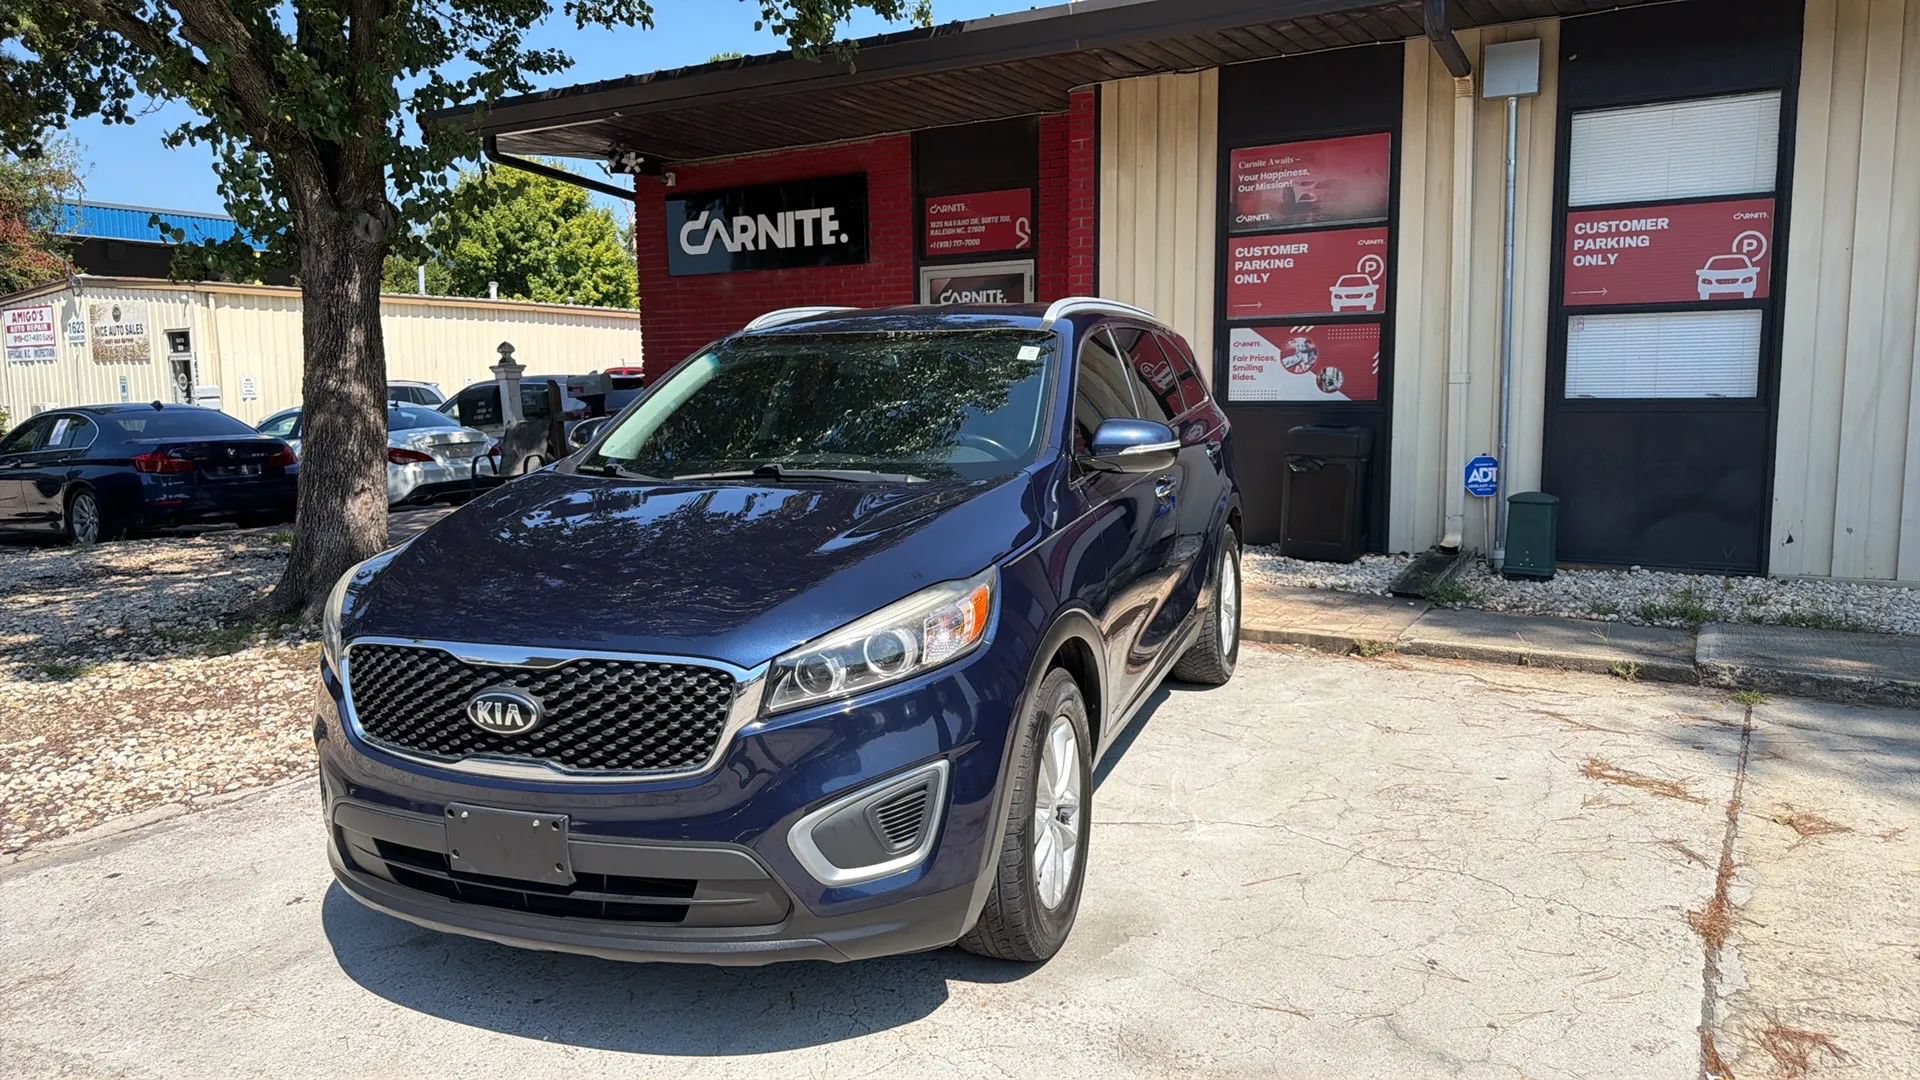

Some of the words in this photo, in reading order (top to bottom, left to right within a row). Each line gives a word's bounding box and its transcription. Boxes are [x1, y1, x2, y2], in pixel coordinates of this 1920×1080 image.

[1238, 160, 1266, 169] Carnite
[1268, 157, 1294, 166] Awaits
[1238, 174, 1258, 182] Your
[1238, 184, 1256, 193] Our
[1256, 180, 1293, 191] Mission!
[930, 227, 955, 236] RALEIGH
[1574, 217, 1669, 235] CUSTOMER
[1573, 235, 1650, 251] PARKING
[1235, 243, 1308, 258] CUSTOMER
[1234, 258, 1294, 271] PARKING
[1572, 252, 1618, 267] ONLY
[1234, 272, 1270, 285] ONLY
[12, 310, 44, 323] AMIGO'S
[68, 321, 85, 334] 1623
[109, 325, 124, 337] AUTO
[125, 323, 144, 336] SALES
[1232, 354, 1249, 362] Fair
[1232, 363, 1263, 373] Smiling
[1232, 373, 1256, 381] Rides.
[1468, 467, 1497, 483] ADT
[476, 701, 524, 726] KIA
